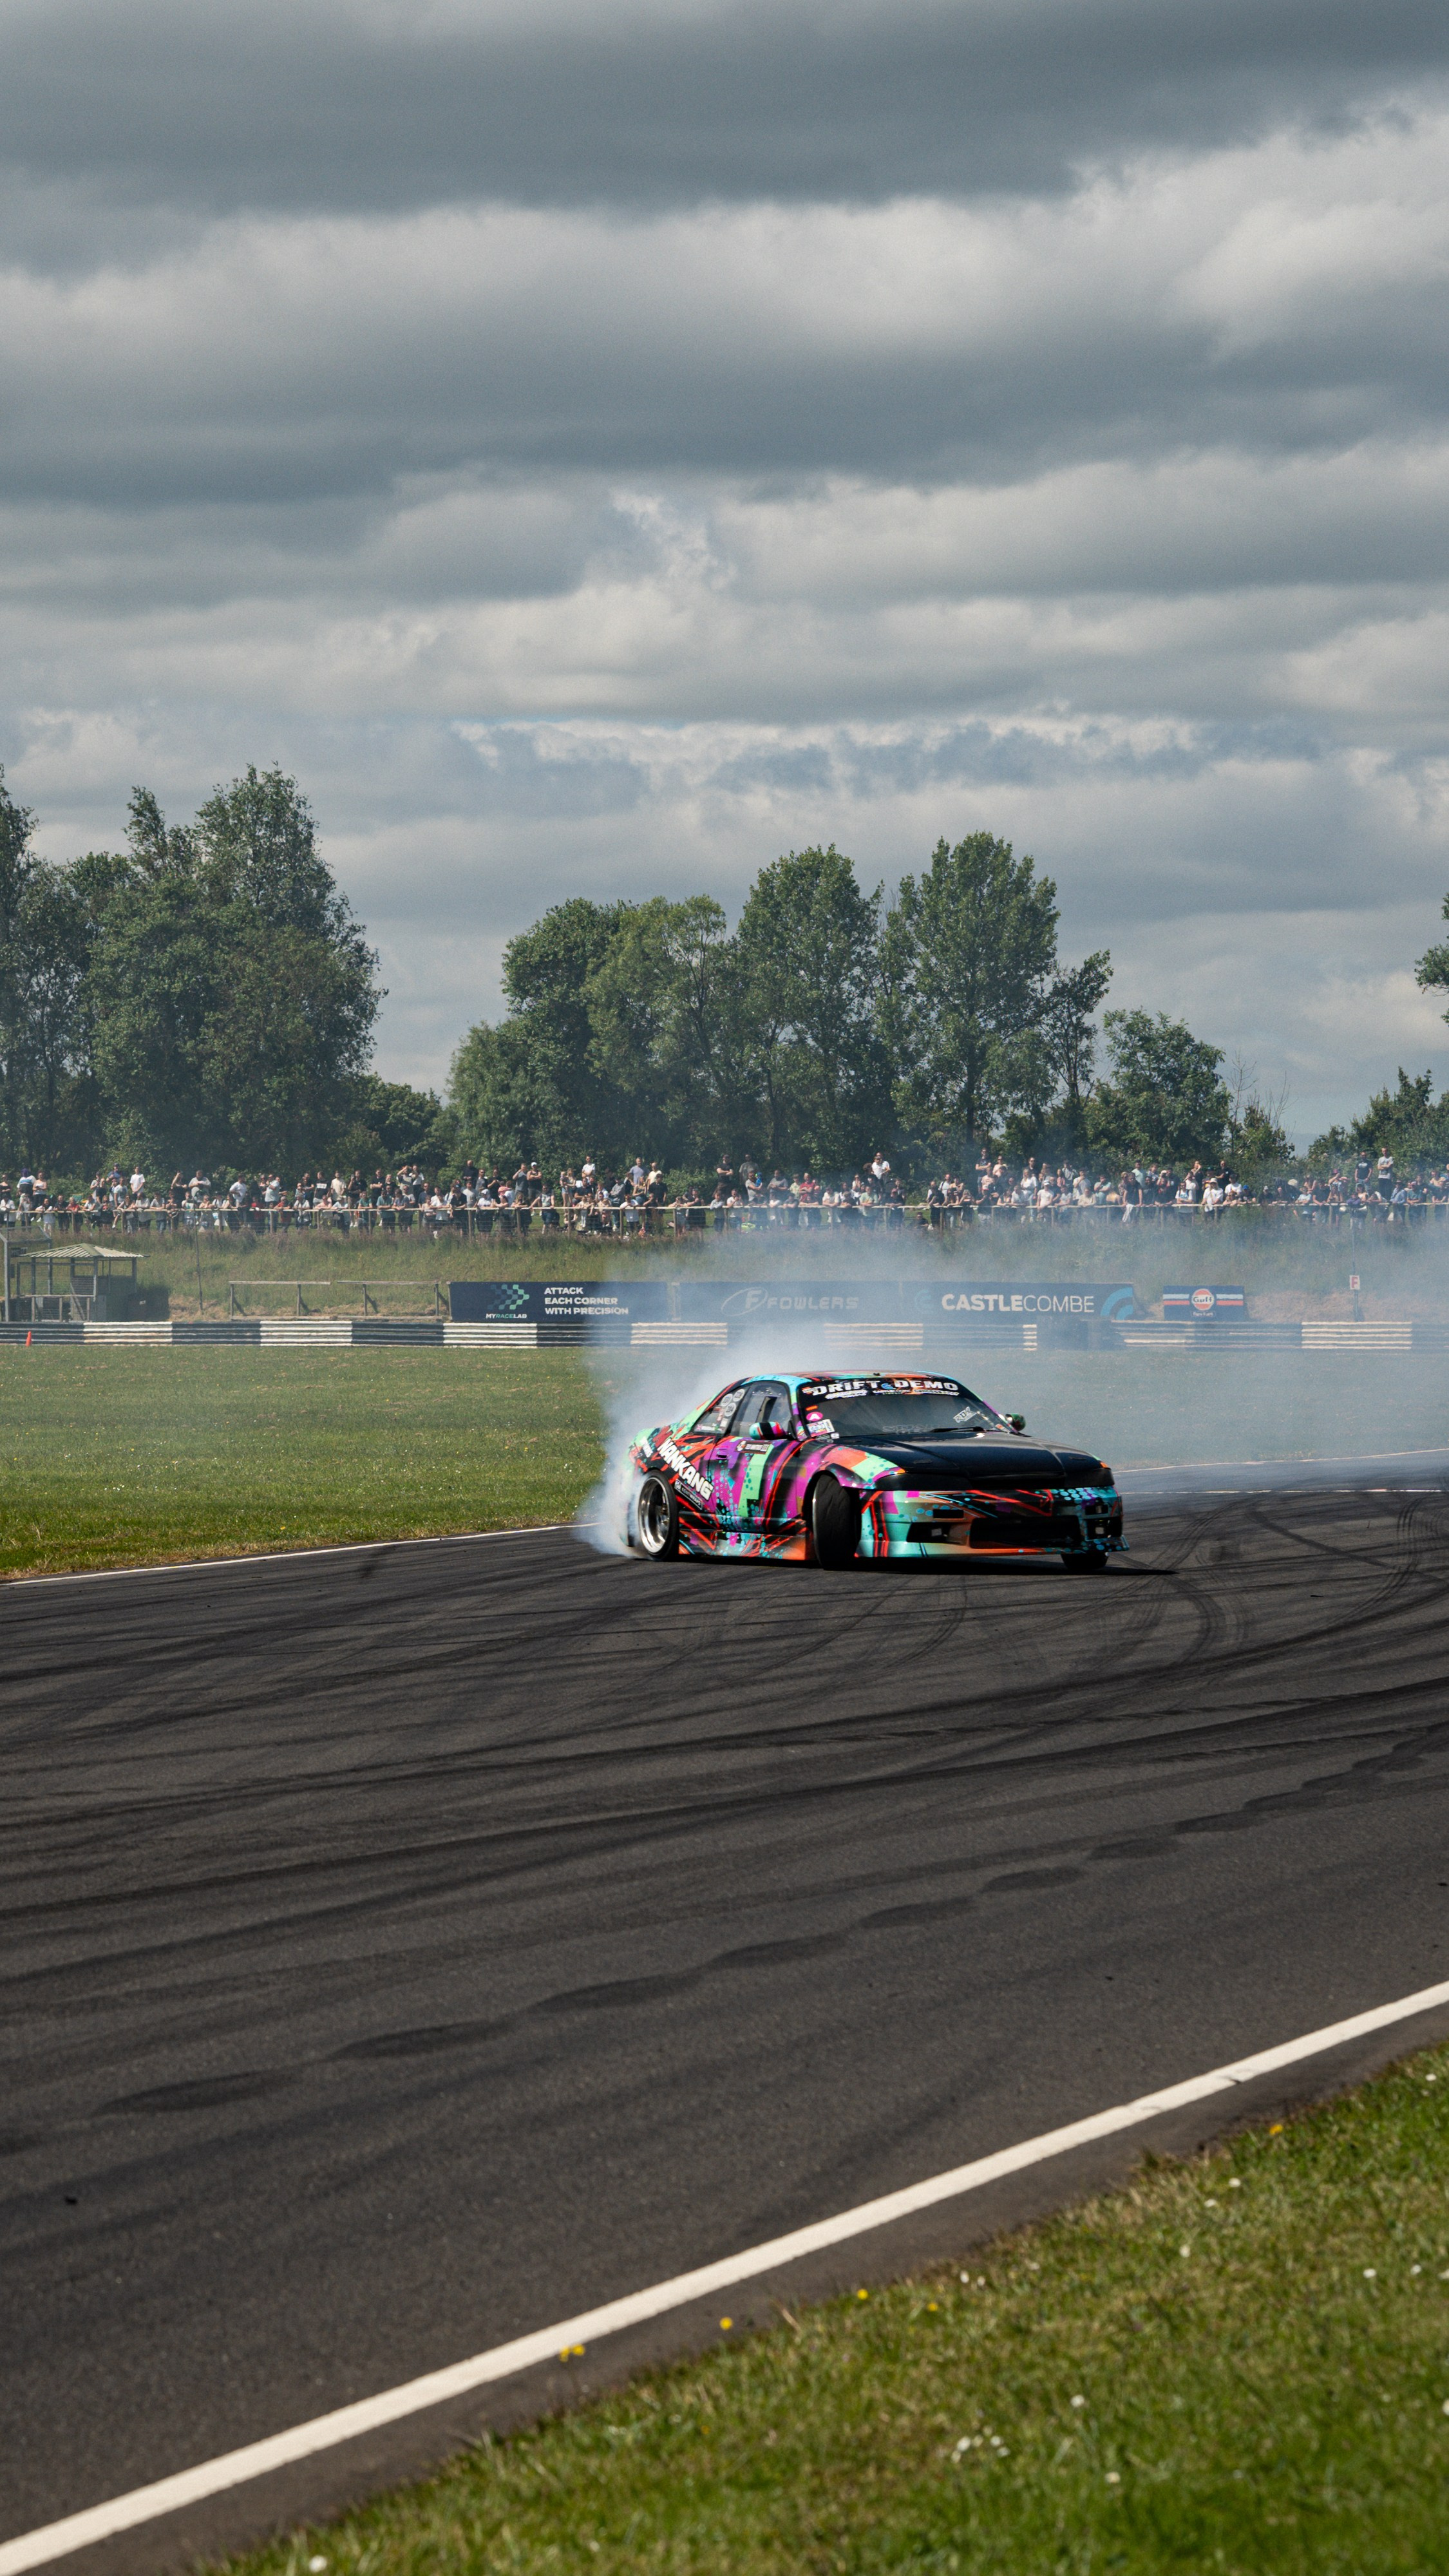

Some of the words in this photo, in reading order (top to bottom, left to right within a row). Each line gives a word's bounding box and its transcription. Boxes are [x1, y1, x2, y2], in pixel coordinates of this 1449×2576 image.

[1351, 1276, 1358, 1289] F
[767, 1296, 859, 1310] FOWLERS
[812, 1380, 881, 1396] DRIFT
[894, 1379, 959, 1391] DEMO
[657, 1438, 714, 1501] NANKANG
